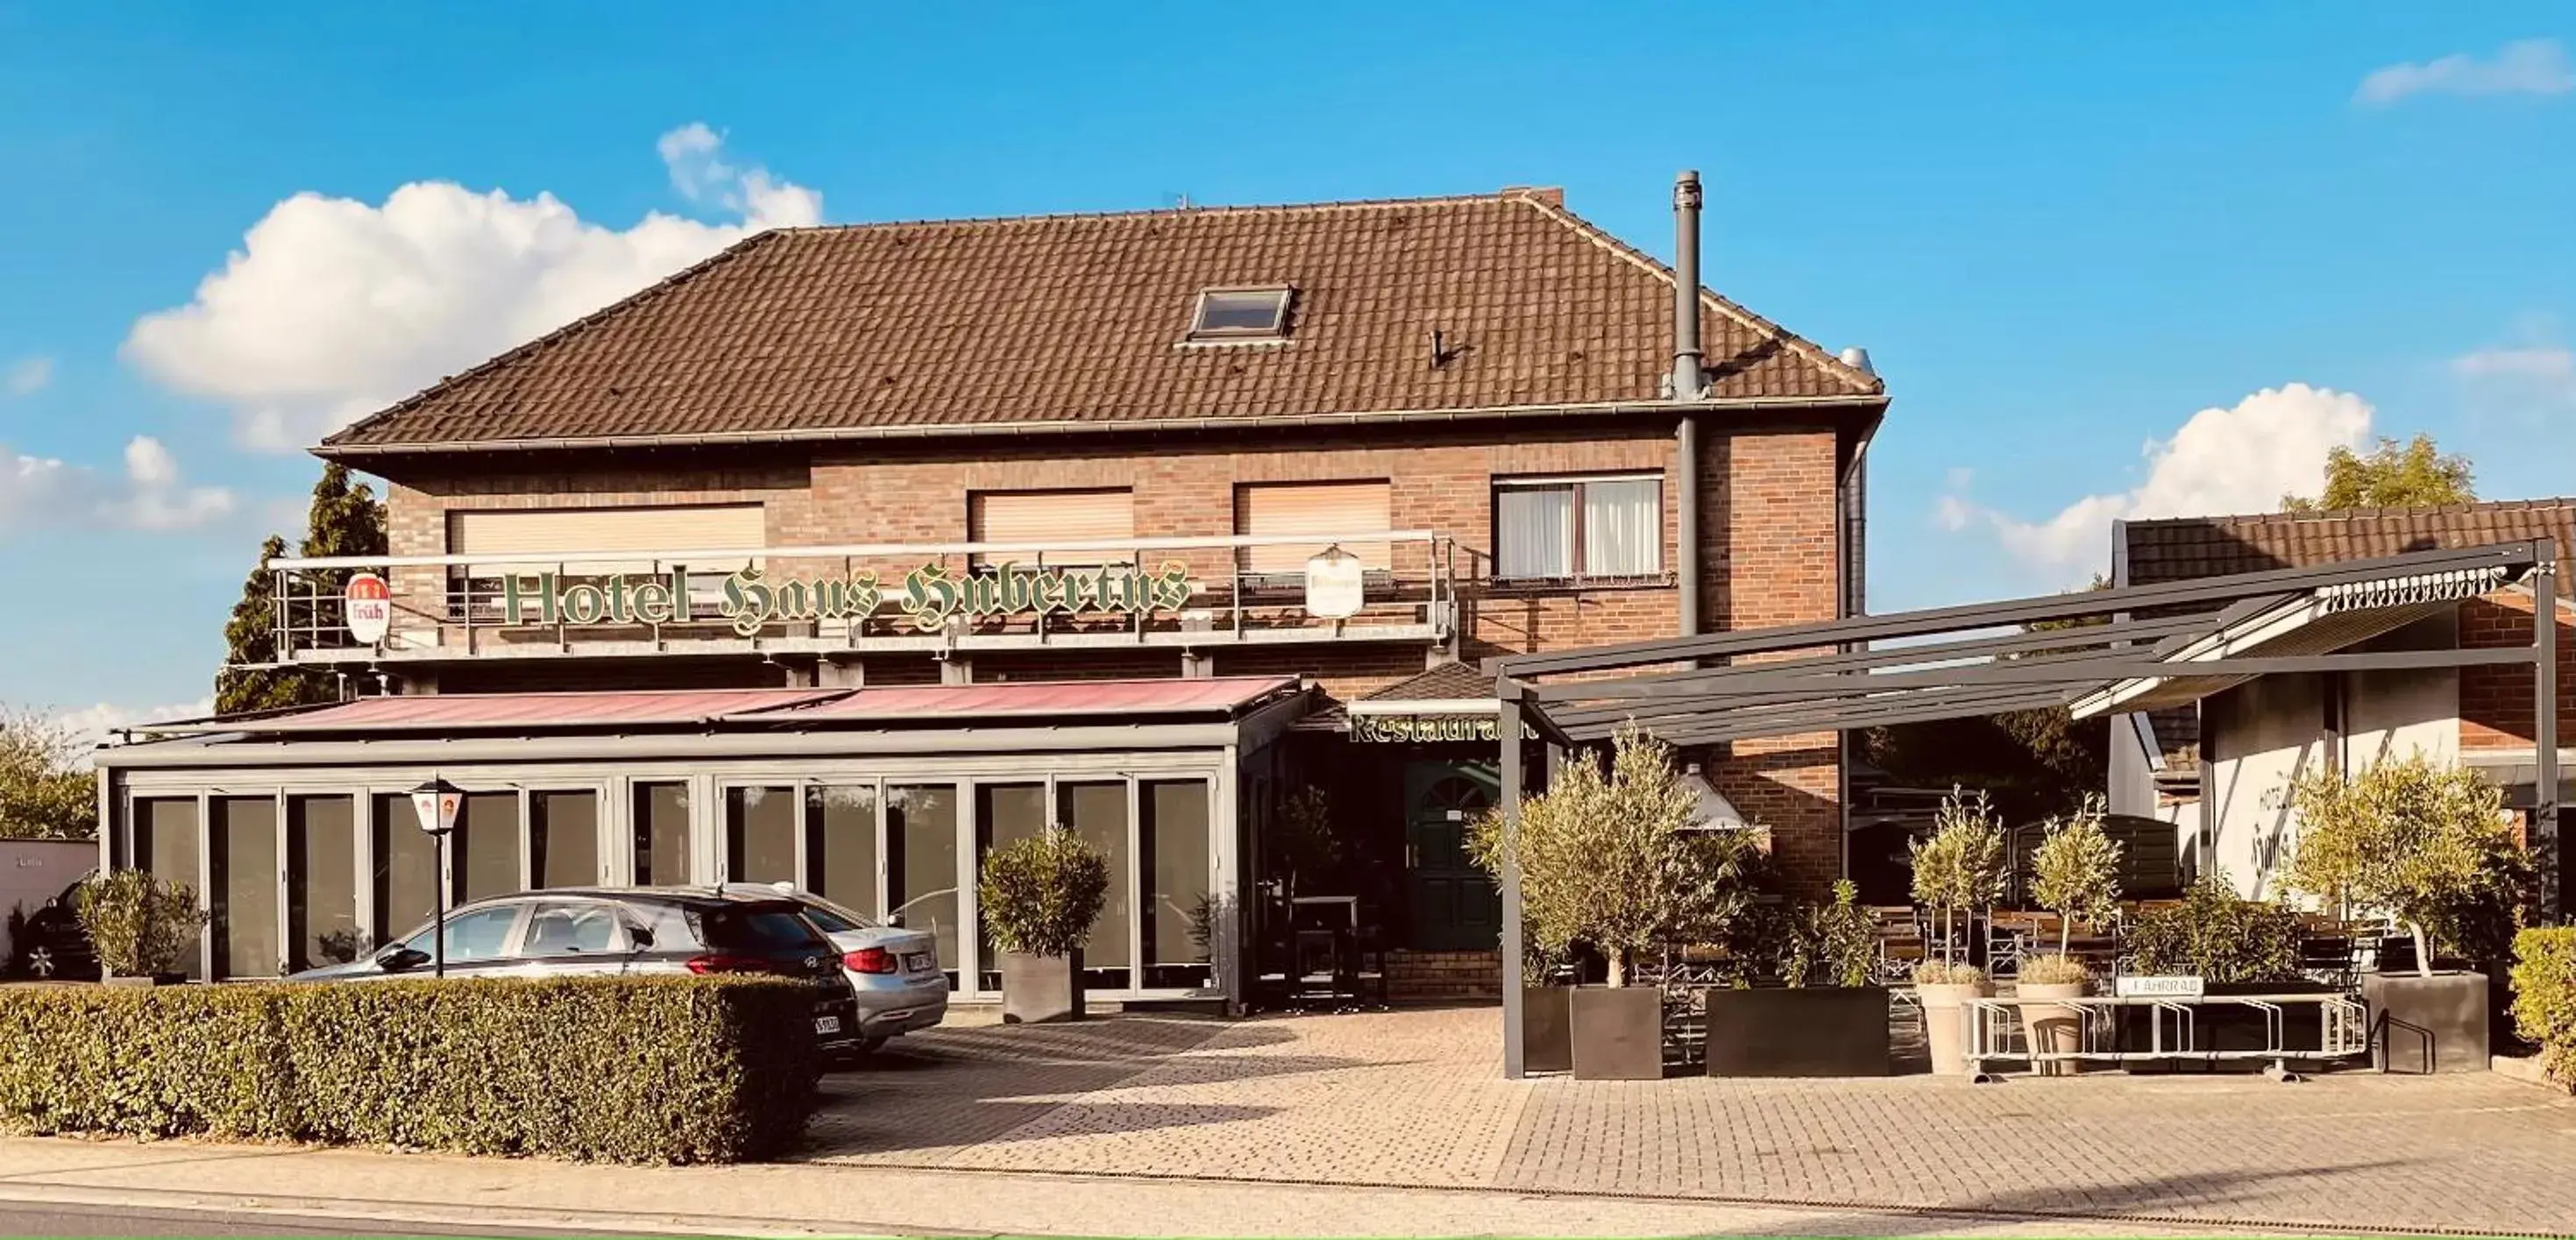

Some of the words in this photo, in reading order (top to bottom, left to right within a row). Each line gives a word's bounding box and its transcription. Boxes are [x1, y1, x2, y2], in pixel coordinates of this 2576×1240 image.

[353, 602, 384, 620] früh
[504, 564, 691, 625] Hotel
[718, 565, 883, 635] Haus
[901, 560, 1191, 633] Hubertus
[1349, 713, 1539, 743] Restaurat
